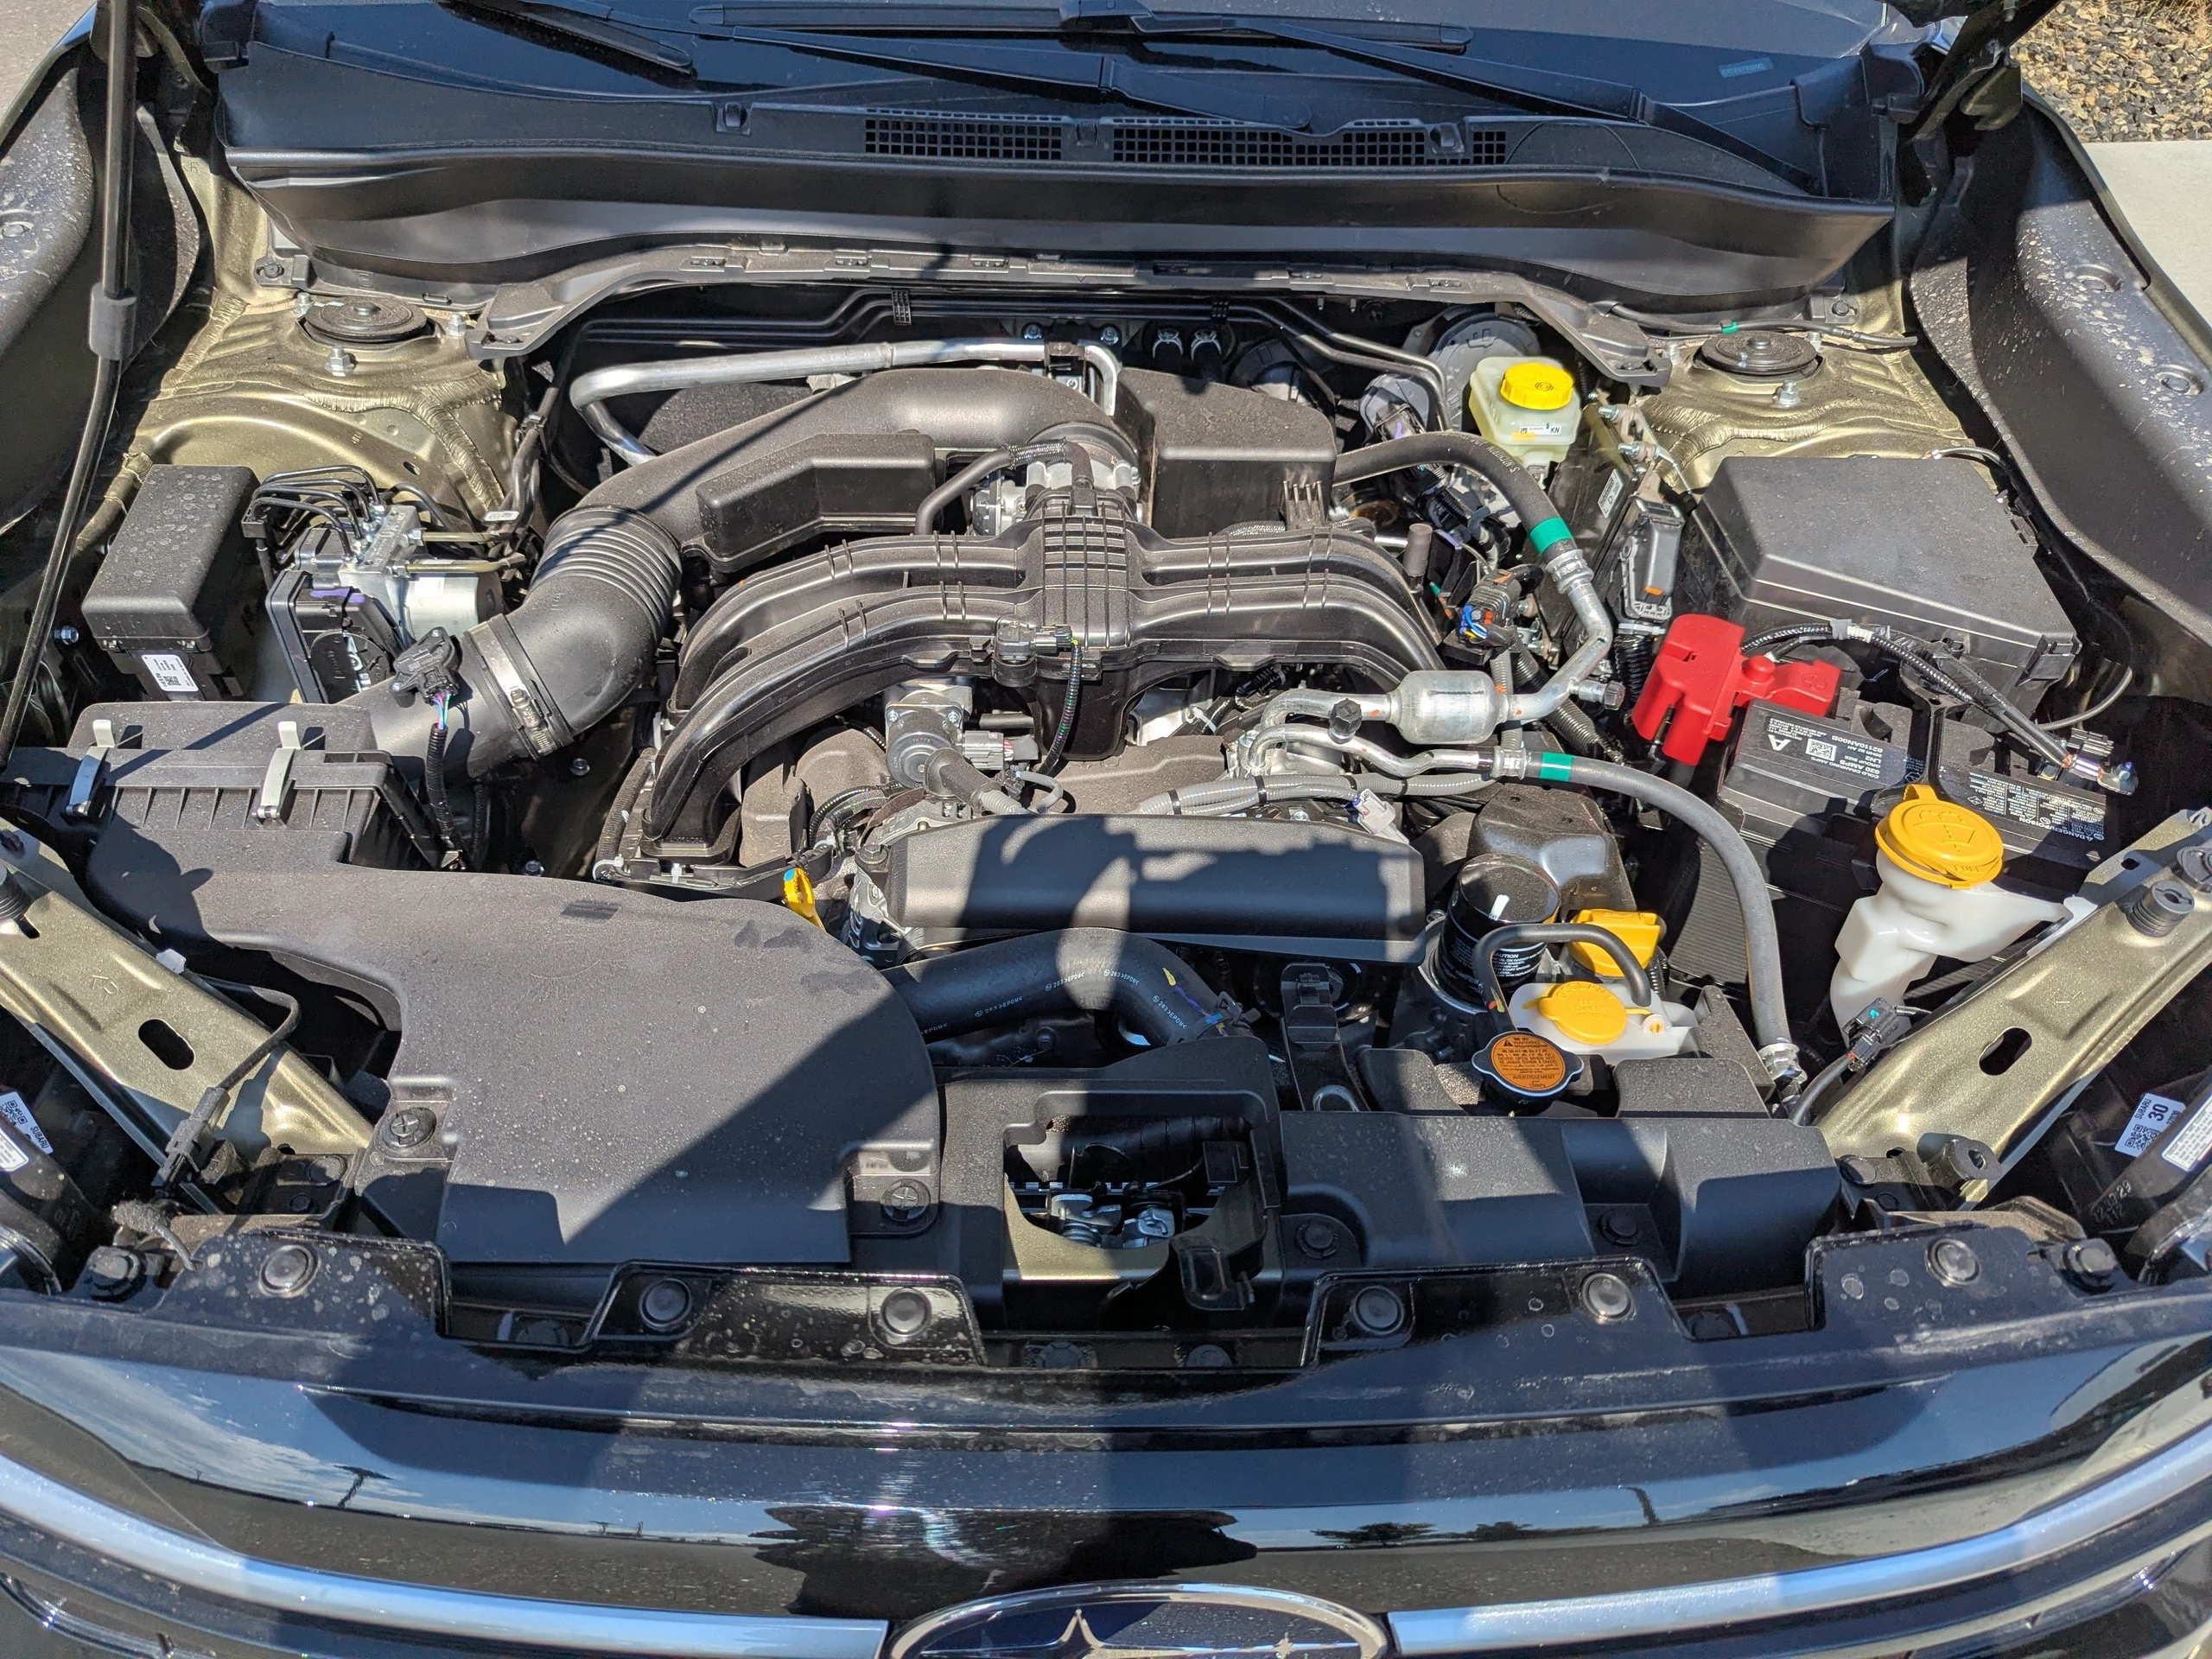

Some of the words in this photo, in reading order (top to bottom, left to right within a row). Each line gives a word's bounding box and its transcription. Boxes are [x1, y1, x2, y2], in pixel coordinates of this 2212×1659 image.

[1831, 734, 1884, 753] 82110AN00B
[1810, 756, 1828, 765] AMPS
[1839, 760, 1865, 770] AMPS
[1865, 755, 1881, 764] LN2
[1829, 761, 1861, 774] CRANKING
[1865, 766, 1880, 775] 620
[1862, 771, 1879, 779] COLD
[2135, 1098, 2152, 1120] SUBARU
[2148, 1103, 2169, 1122] 30
[30, 1125, 50, 1150] SUBARU
